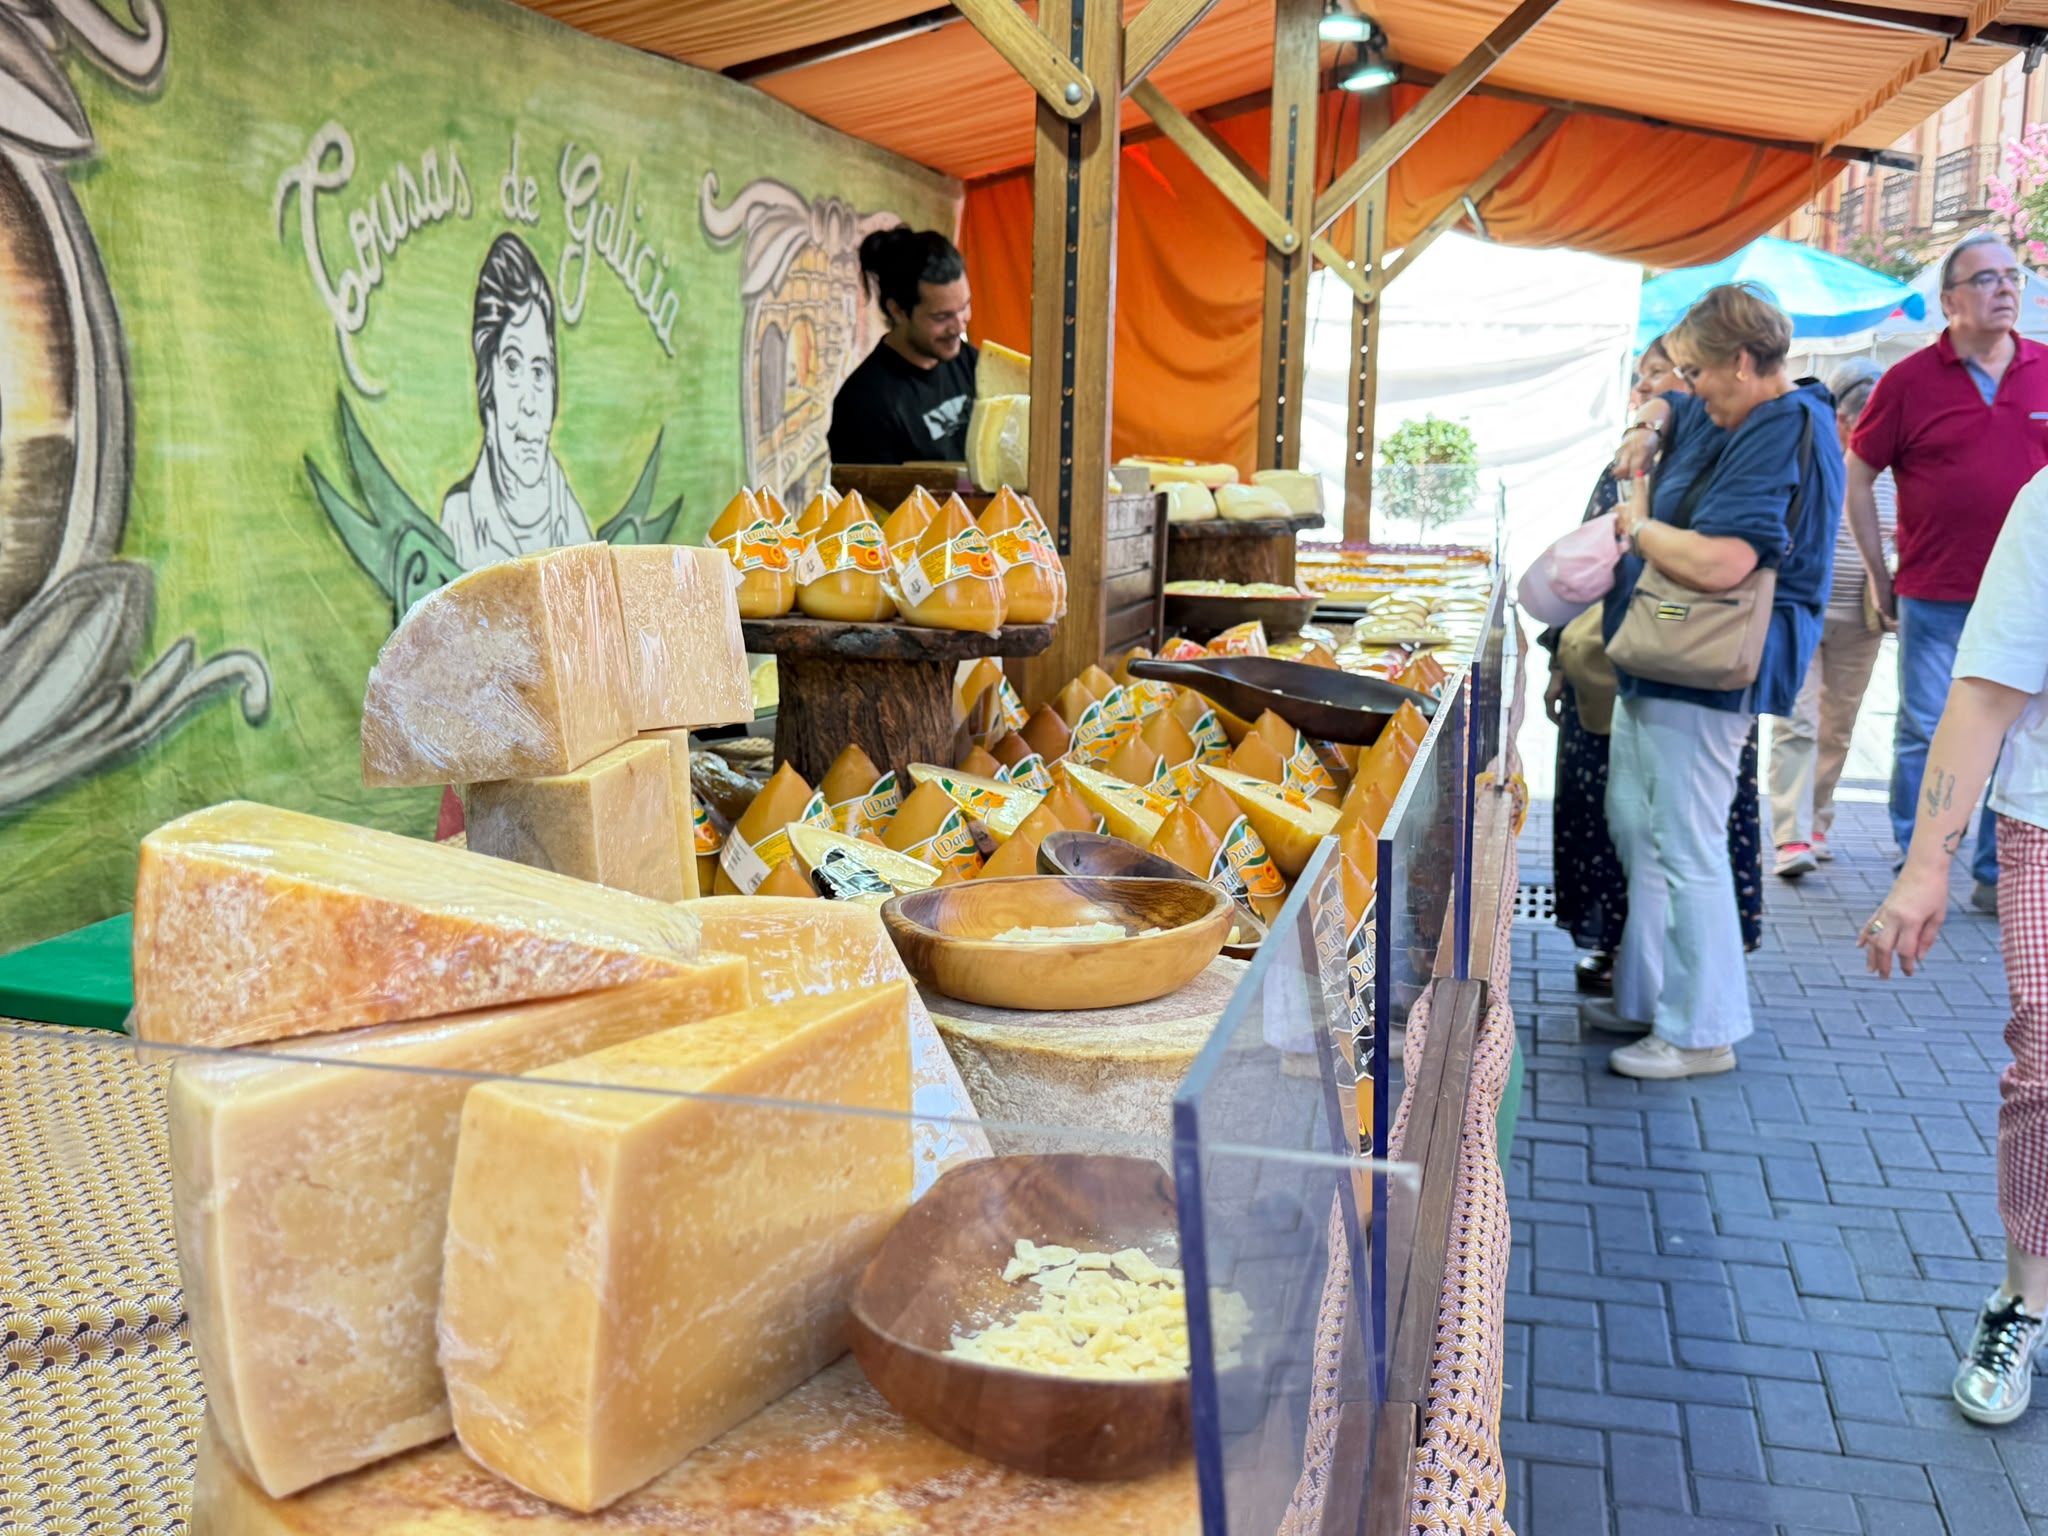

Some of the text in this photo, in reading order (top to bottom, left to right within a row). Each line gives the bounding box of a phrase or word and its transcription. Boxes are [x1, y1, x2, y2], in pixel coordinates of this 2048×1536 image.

[276, 120, 680, 396] Cousas de Galicia
